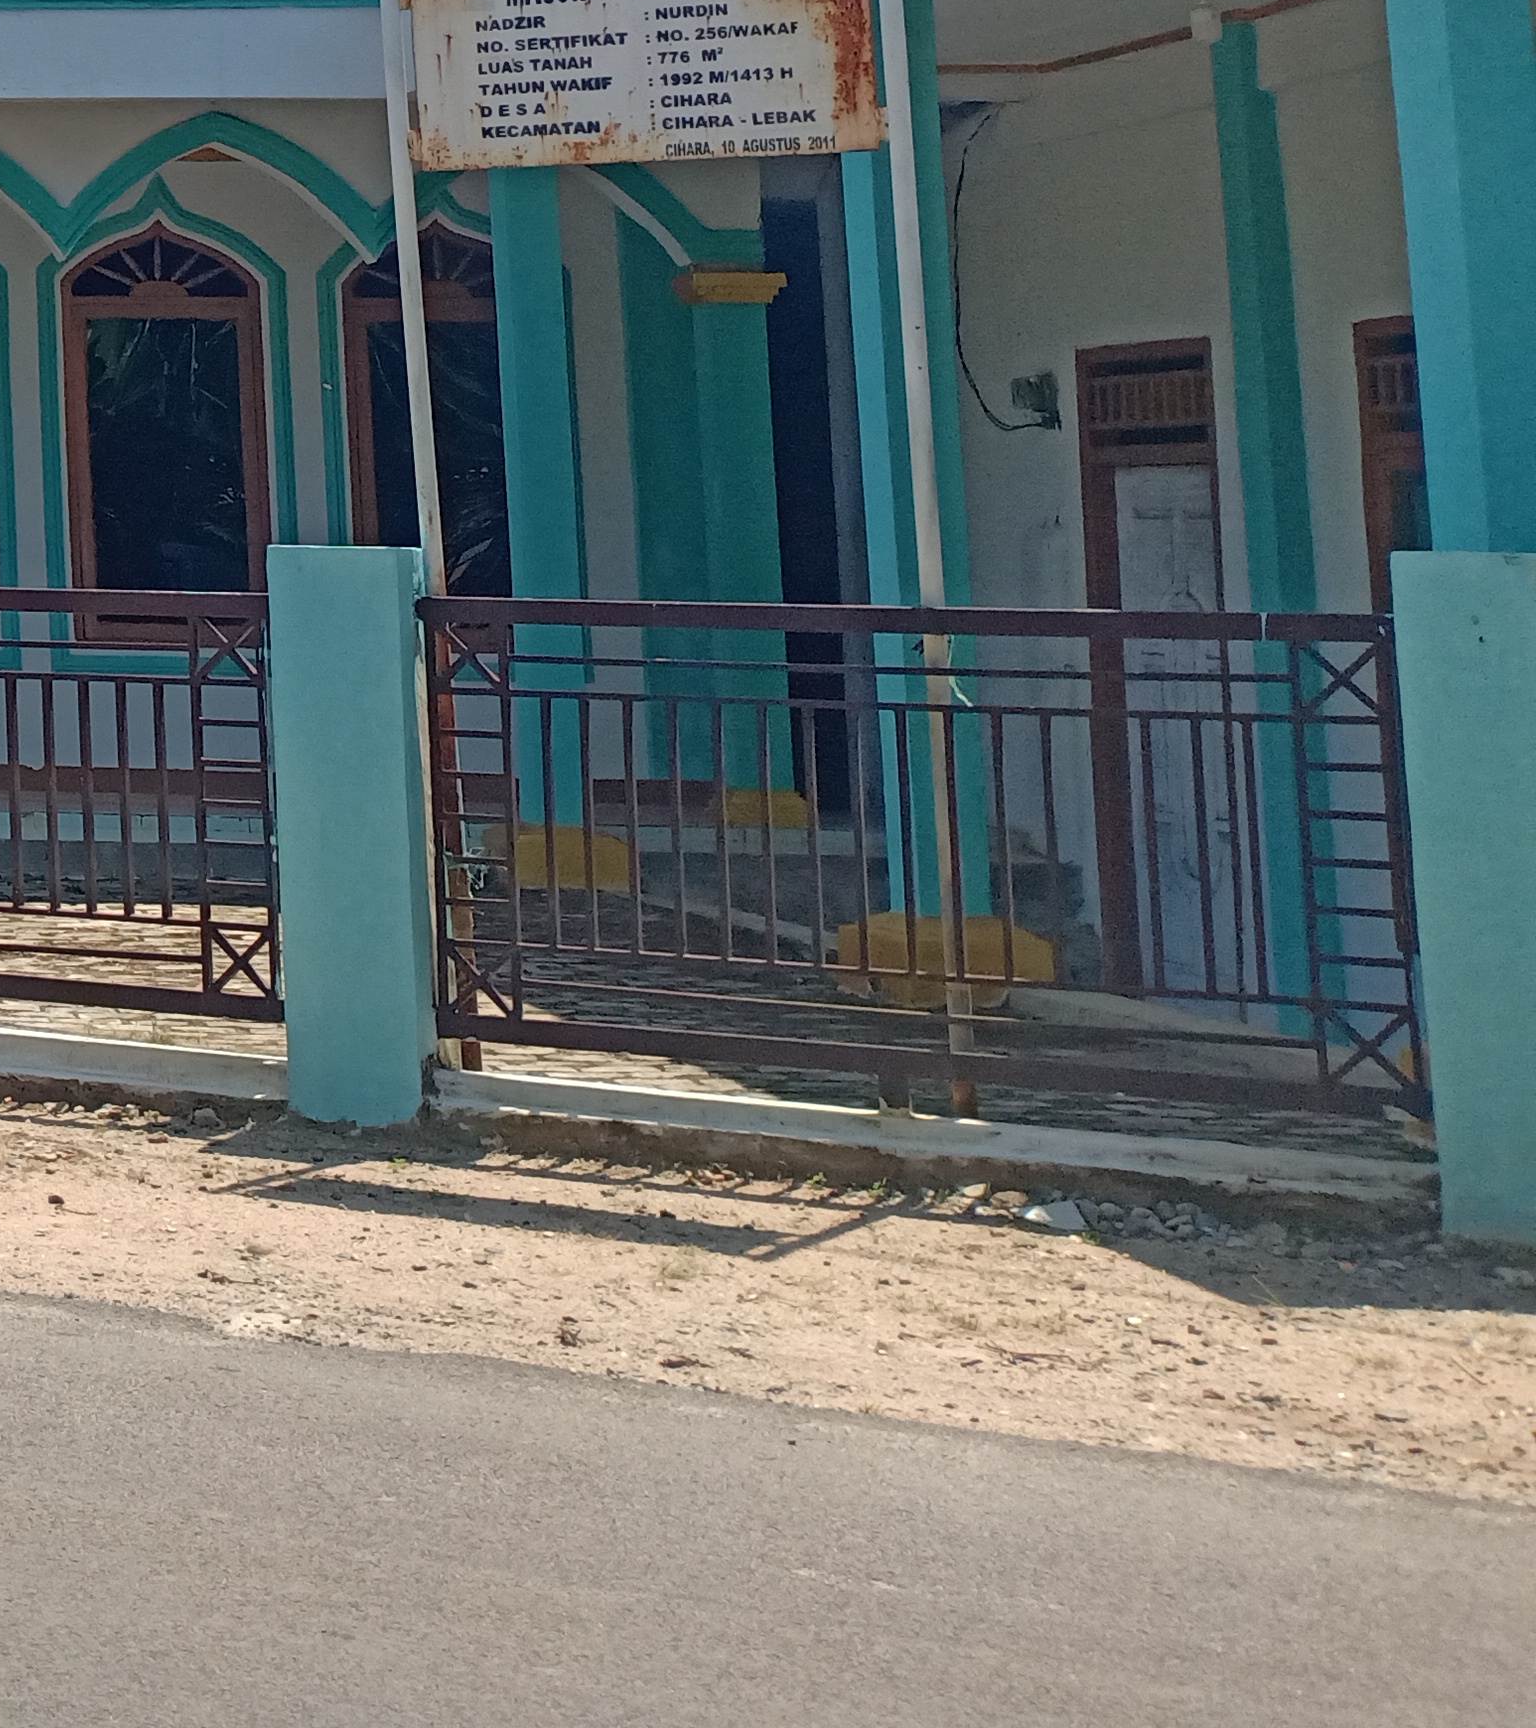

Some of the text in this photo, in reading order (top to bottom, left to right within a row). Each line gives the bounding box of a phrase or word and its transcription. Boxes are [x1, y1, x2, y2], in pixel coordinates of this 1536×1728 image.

[475, 16, 546, 33] NADZIR
[655, 4, 728, 20] NURDIN
[476, 41, 509, 54] NO.
[515, 33, 628, 51] SERTIFIKAT
[657, 30, 690, 43] NO.
[695, 22, 799, 41] 256/WAKAF
[478, 61, 524, 75] LUAS
[530, 57, 593, 72] TANAH
[658, 51, 691, 65] 776
[478, 81, 545, 96] TAHUN
[550, 76, 613, 92] WAKIF
[660, 73, 704, 86] 1992
[709, 68, 774, 84] M/1413
[781, 67, 793, 79] H
[660, 93, 733, 108] CIHARA
[481, 121, 601, 139] KECAMATAN
[662, 115, 734, 130] CIHARA
[752, 109, 817, 126] LEBAK
[665, 136, 837, 158] CIHARA, 10 AGUSTUS 2011
